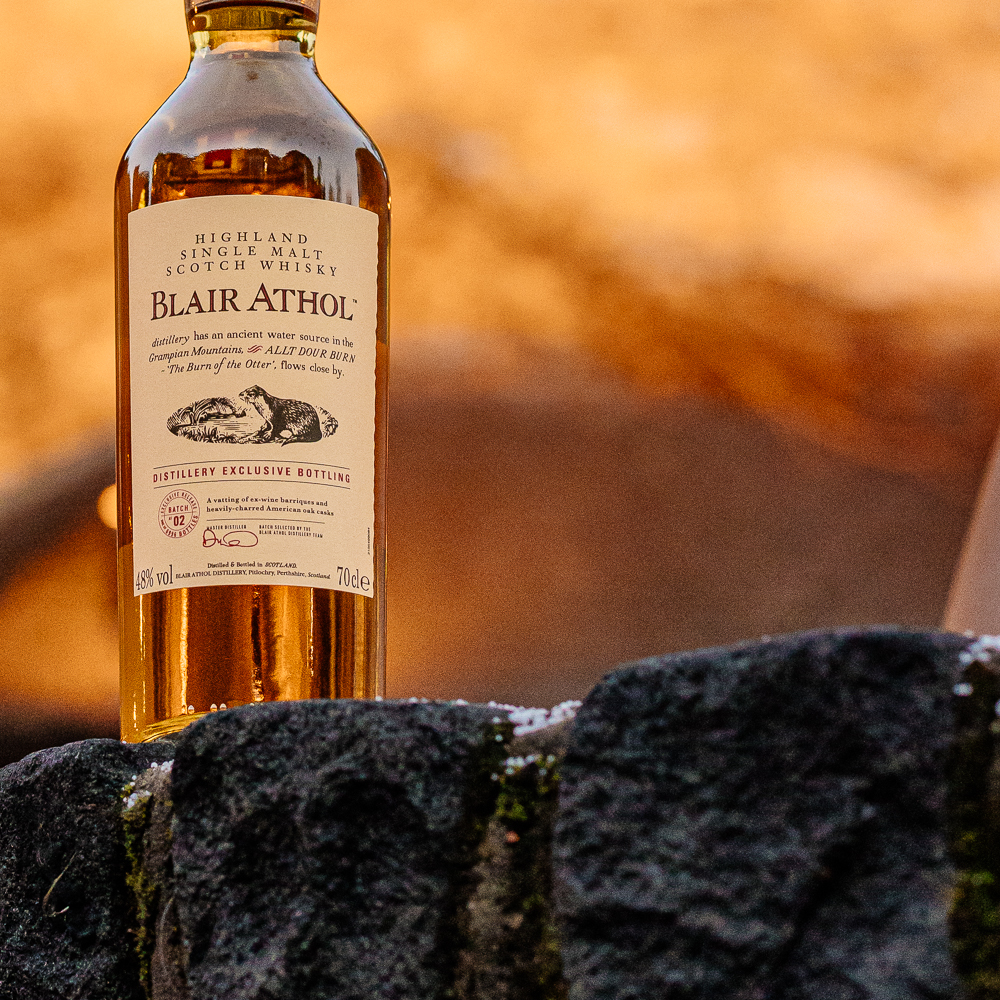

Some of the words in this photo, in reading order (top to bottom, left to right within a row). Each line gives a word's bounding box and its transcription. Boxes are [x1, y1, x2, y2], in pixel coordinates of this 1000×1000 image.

[195, 232, 308, 244] HIGHLAND
[180, 246, 256, 260] SINGLE
[271, 246, 323, 260] MALT
[166, 260, 246, 276] SCOTCH
[260, 260, 338, 277] WHISKY
[151, 288, 241, 321] BLAIR
[152, 335, 189, 347] distillery
[194, 331, 208, 340] has
[227, 330, 262, 338] ancient
[300, 334, 329, 343] source
[333, 336, 340, 345] in
[342, 337, 353, 348] the
[149, 349, 189, 363] Grampian
[191, 345, 243, 356] Mountains,
[265, 346, 297, 355] ALLT
[298, 347, 327, 358] DOUR
[330, 350, 356, 363] BURN
[187, 362, 211, 372] Burn
[214, 357, 226, 374] of
[227, 360, 241, 368] the
[281, 360, 305, 370] flows
[310, 363, 329, 373] close
[333, 364, 344, 379] by.
[153, 466, 216, 483] DISTILLERY
[222, 466, 291, 476] EXCLUSIVE
[298, 468, 351, 483] BOTTLING
[280, 497, 314, 505] barriques
[174, 515, 185, 526] 02
[179, 515, 198, 537] BOTTLES
[136, 567, 154, 590] 48%
[156, 564, 173, 586] vol
